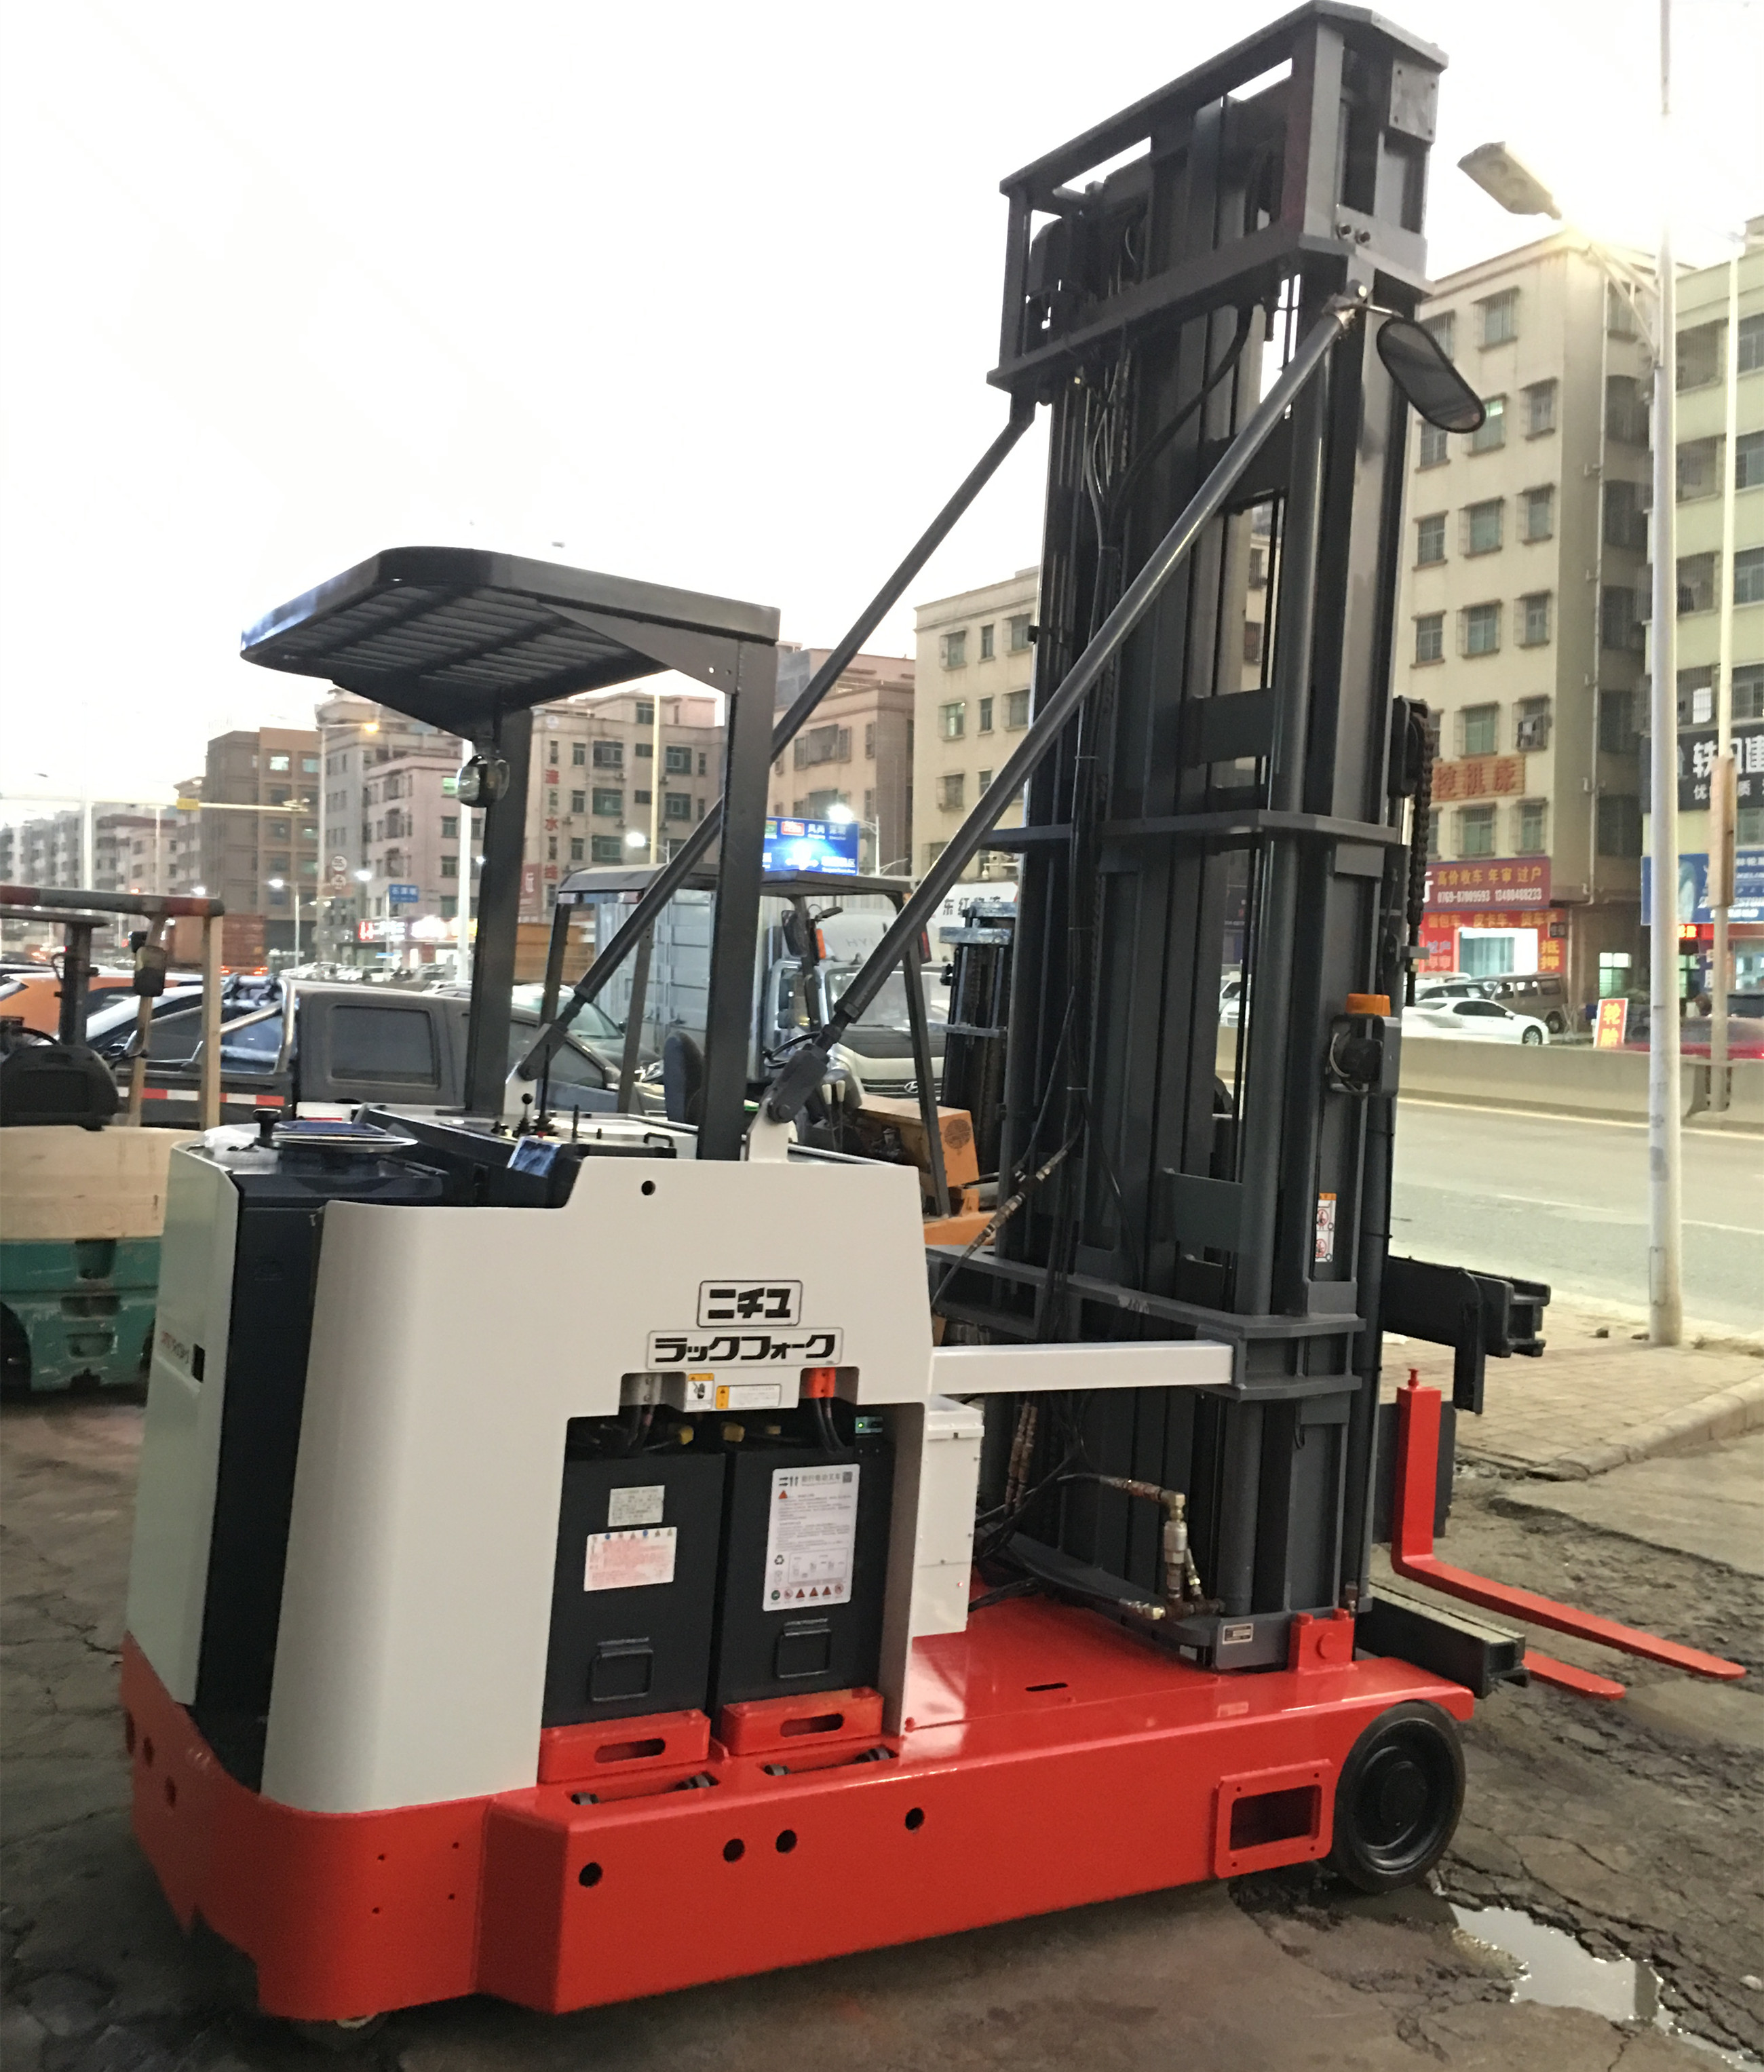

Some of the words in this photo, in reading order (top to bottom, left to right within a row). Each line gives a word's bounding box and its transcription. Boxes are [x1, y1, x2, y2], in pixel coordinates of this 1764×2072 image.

[1438, 869, 1482, 885] 高价收车
[1489, 867, 1512, 883] 年审
[1517, 866, 1542, 882] 过户
[1600, 1003, 1622, 1048] 轮胎
[655, 1334, 836, 1363] ラックフォーク
